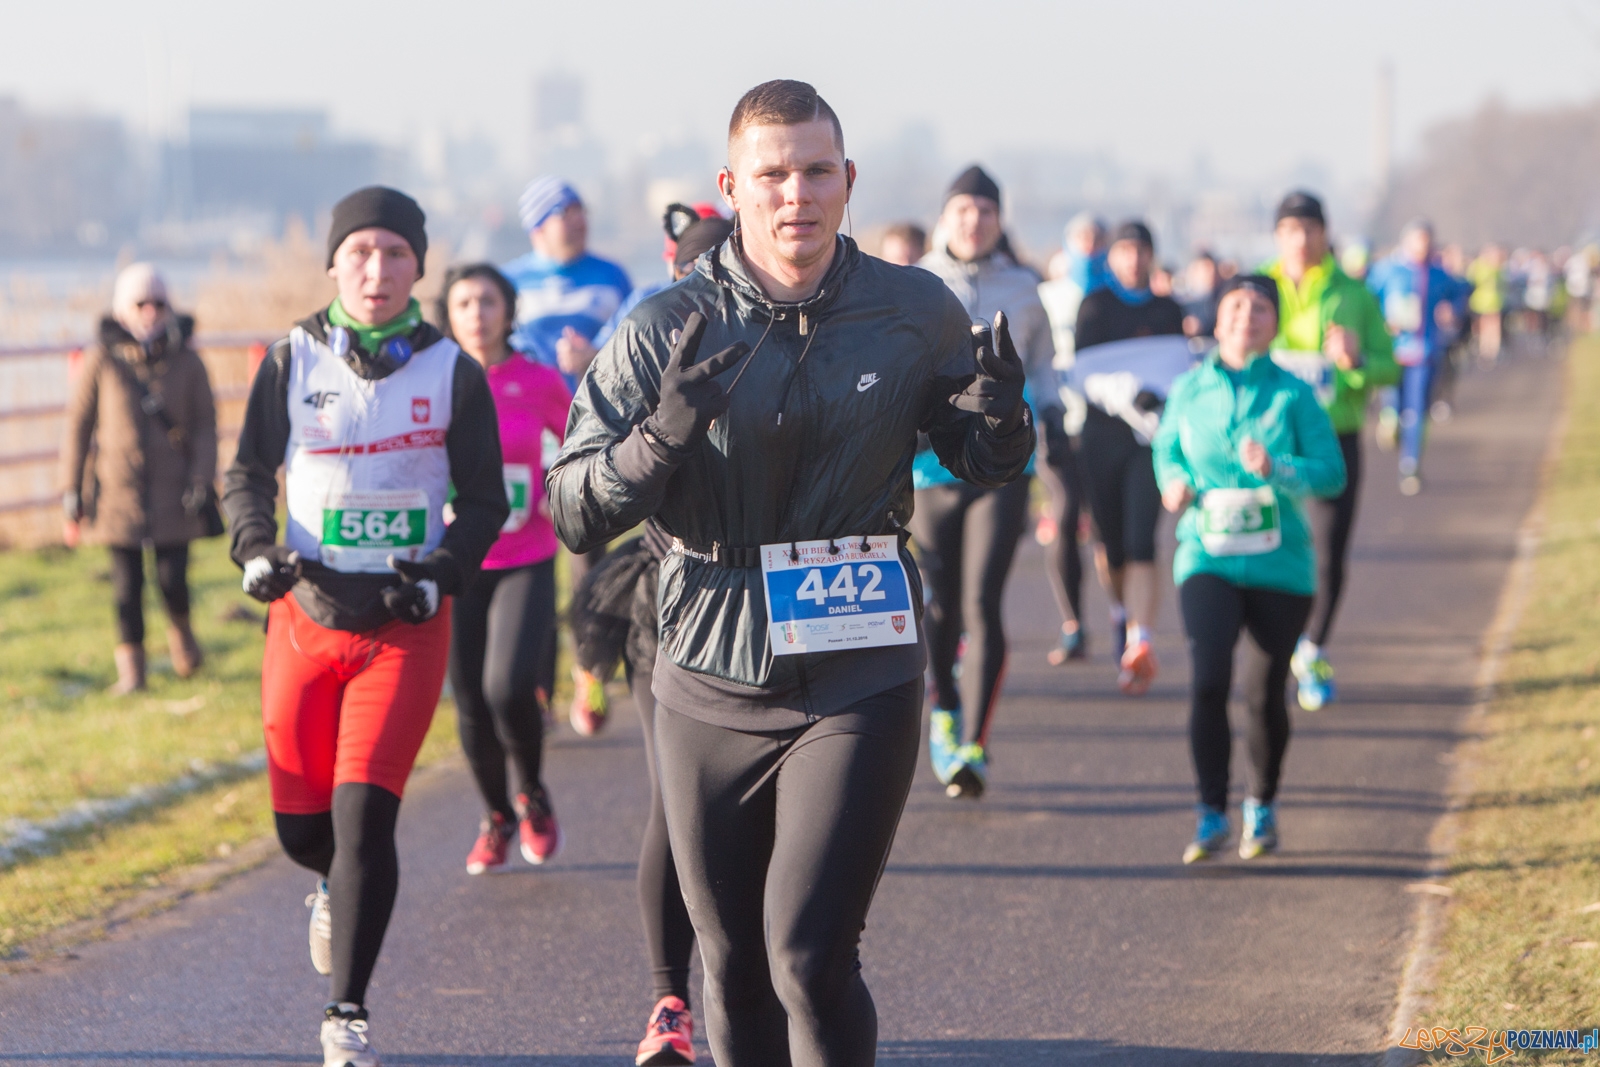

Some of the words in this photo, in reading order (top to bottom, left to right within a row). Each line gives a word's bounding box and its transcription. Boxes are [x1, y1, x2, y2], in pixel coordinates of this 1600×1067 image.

[860, 372, 877, 384] NIKE
[340, 510, 411, 540] 564
[679, 544, 712, 564] kalenji
[796, 564, 886, 606] 442
[828, 604, 862, 615] DANIEL
